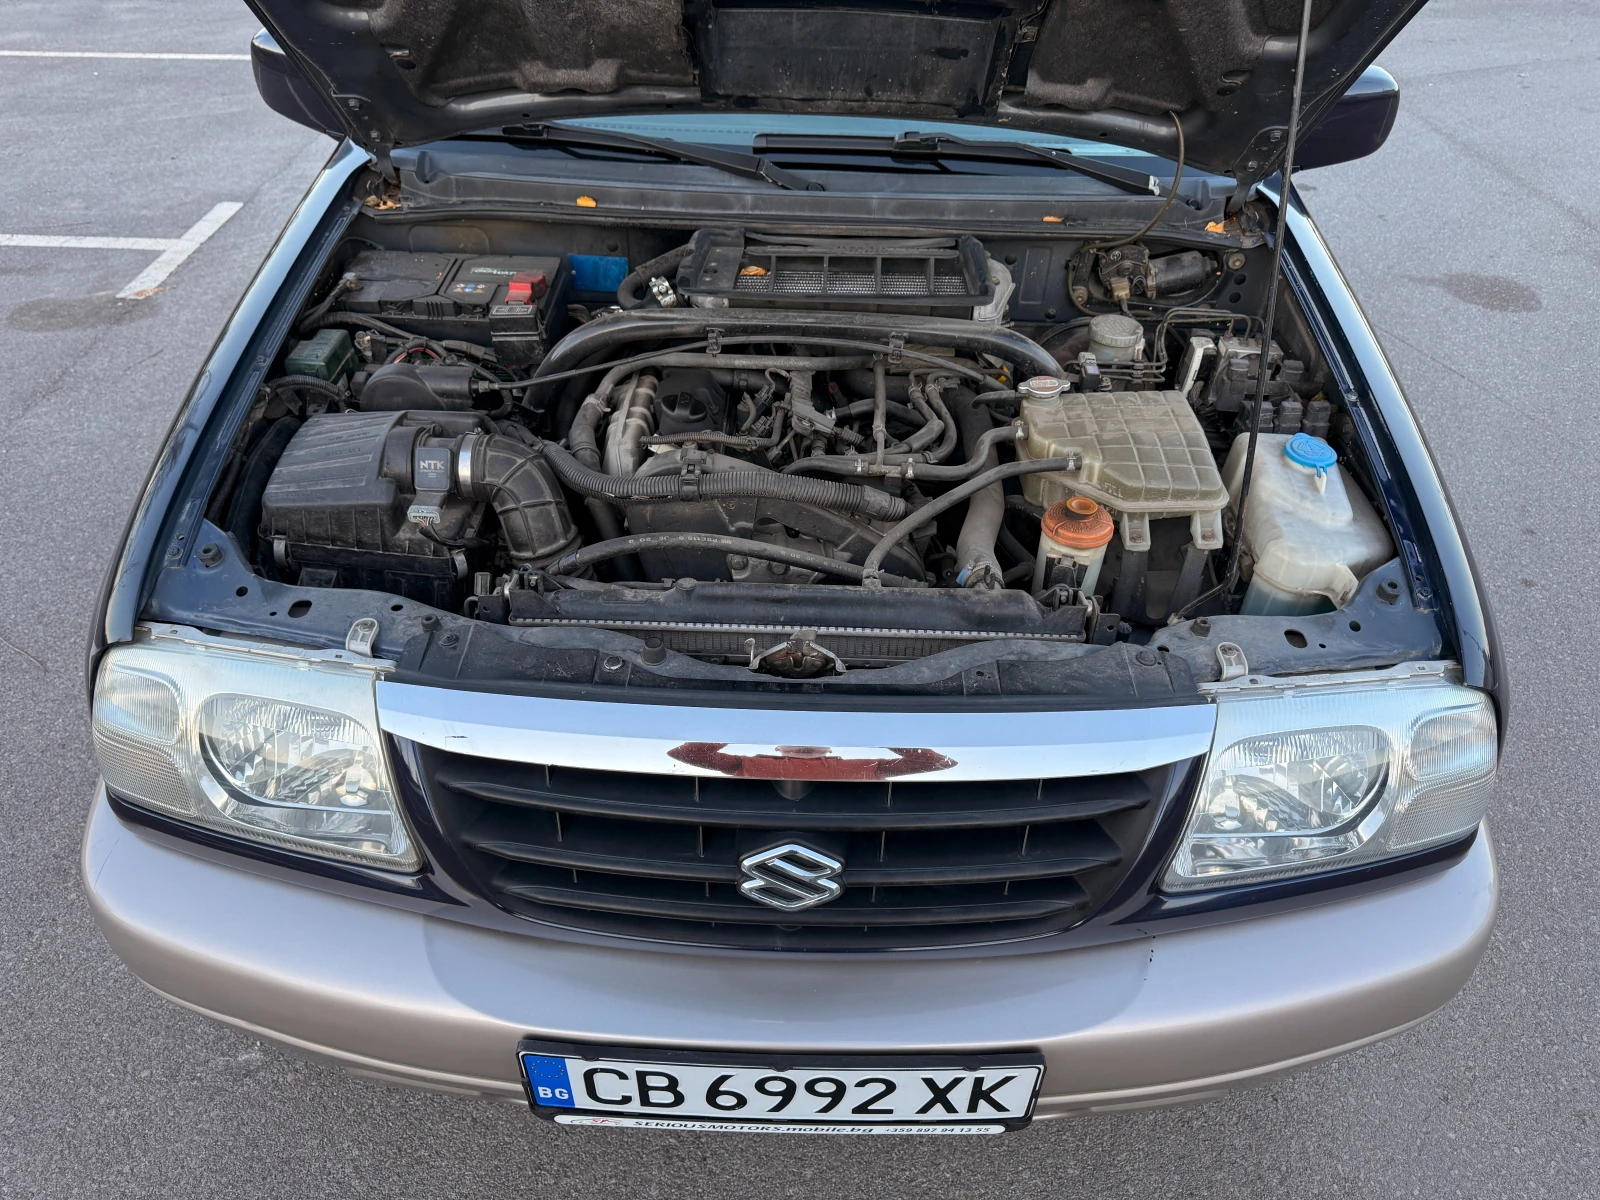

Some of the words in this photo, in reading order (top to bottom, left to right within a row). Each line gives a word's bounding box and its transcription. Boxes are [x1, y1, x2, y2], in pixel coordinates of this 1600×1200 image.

[420, 460, 445, 470] NTK
[538, 1086, 569, 1100] BG
[583, 1067, 685, 1109] CB
[705, 1074, 897, 1115] 6992
[914, 1075, 1018, 1115] XK
[634, 1121, 874, 1134] SERIOUSMOTORS.mobile.bg
